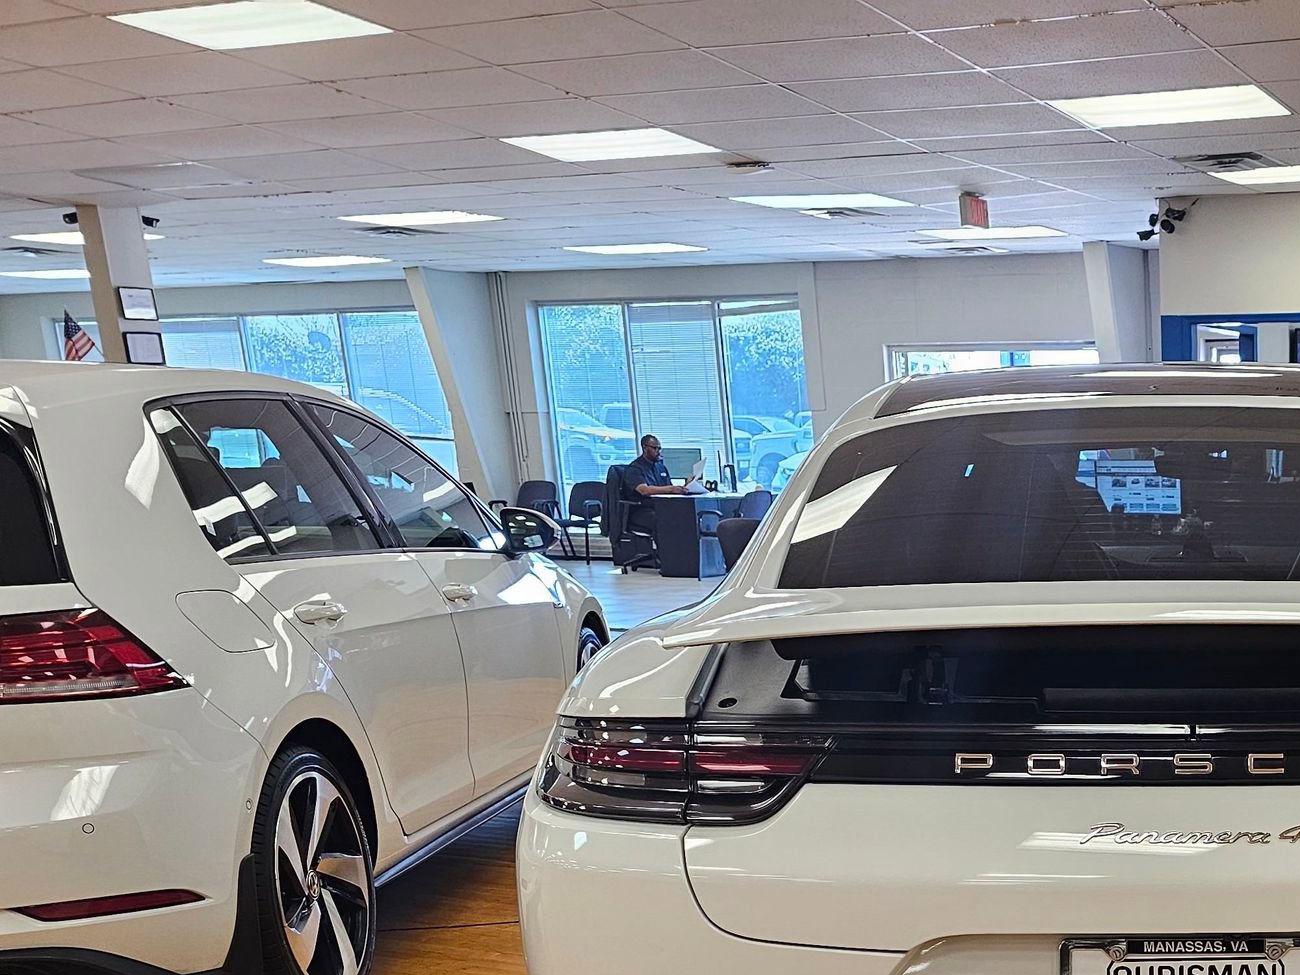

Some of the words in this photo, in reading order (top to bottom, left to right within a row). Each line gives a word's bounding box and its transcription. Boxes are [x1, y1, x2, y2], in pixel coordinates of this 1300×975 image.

[1079, 821, 1271, 846] Panamera
[1143, 940, 1227, 953] MANASSAS,
[1230, 940, 1249, 952] VA
